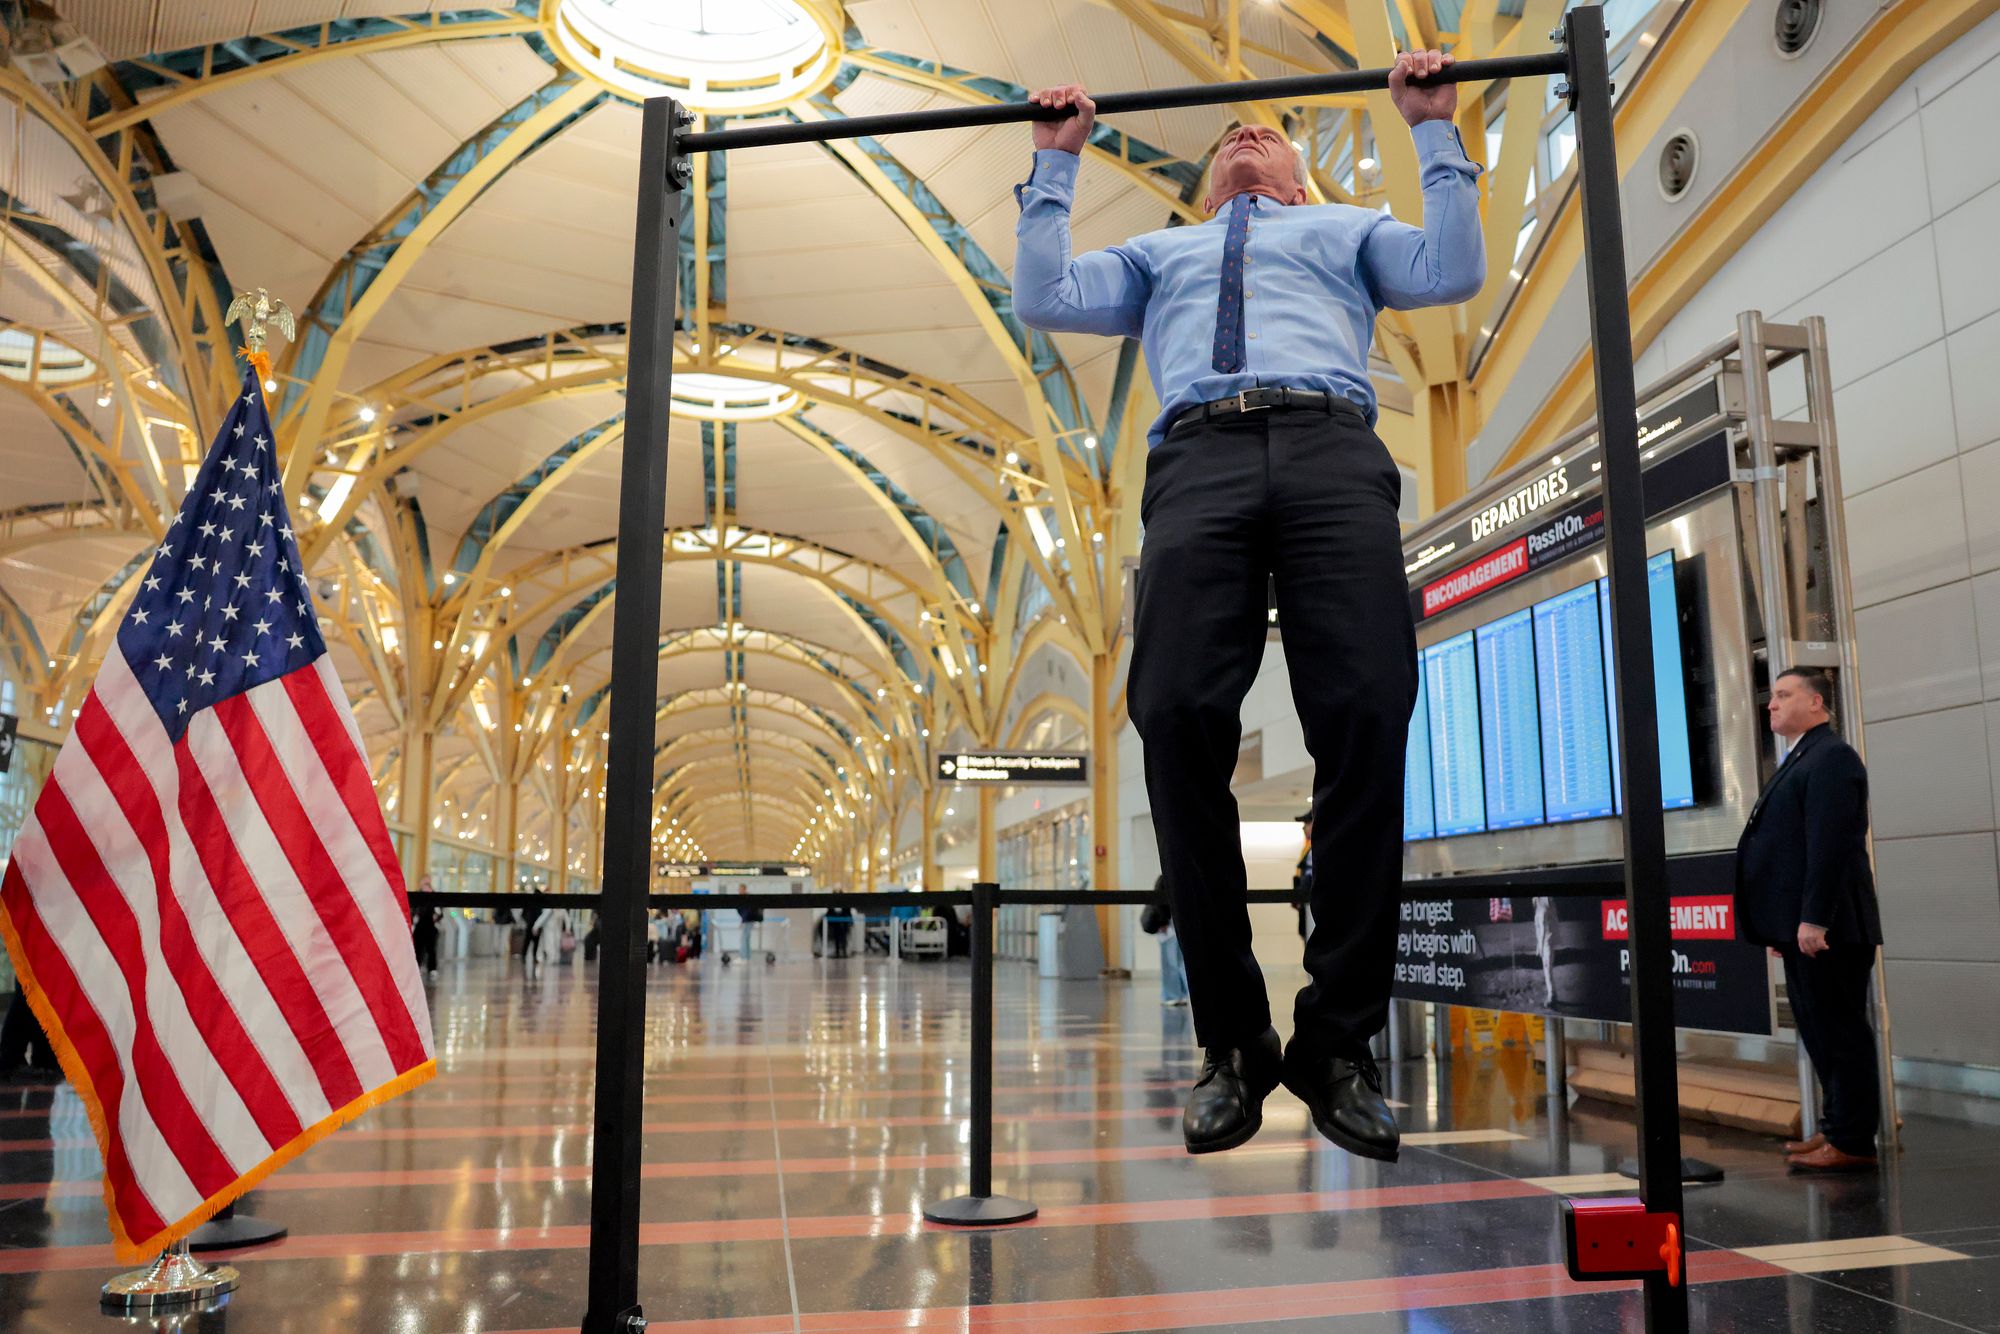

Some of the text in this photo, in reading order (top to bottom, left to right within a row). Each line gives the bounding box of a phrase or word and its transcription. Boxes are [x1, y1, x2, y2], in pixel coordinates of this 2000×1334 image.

[1471, 467, 1569, 542] DEPARTURES
[1527, 510, 1603, 555] PassItOn.com
[1425, 545, 1525, 610] ENCOURAGEMENT
[1412, 899, 1454, 927] longest
[1606, 905, 1729, 931] ACEMENT
[1412, 928, 1450, 958] begins
[1450, 929, 1476, 954] with
[1407, 961, 1436, 984] small
[1437, 962, 1466, 991] step.
